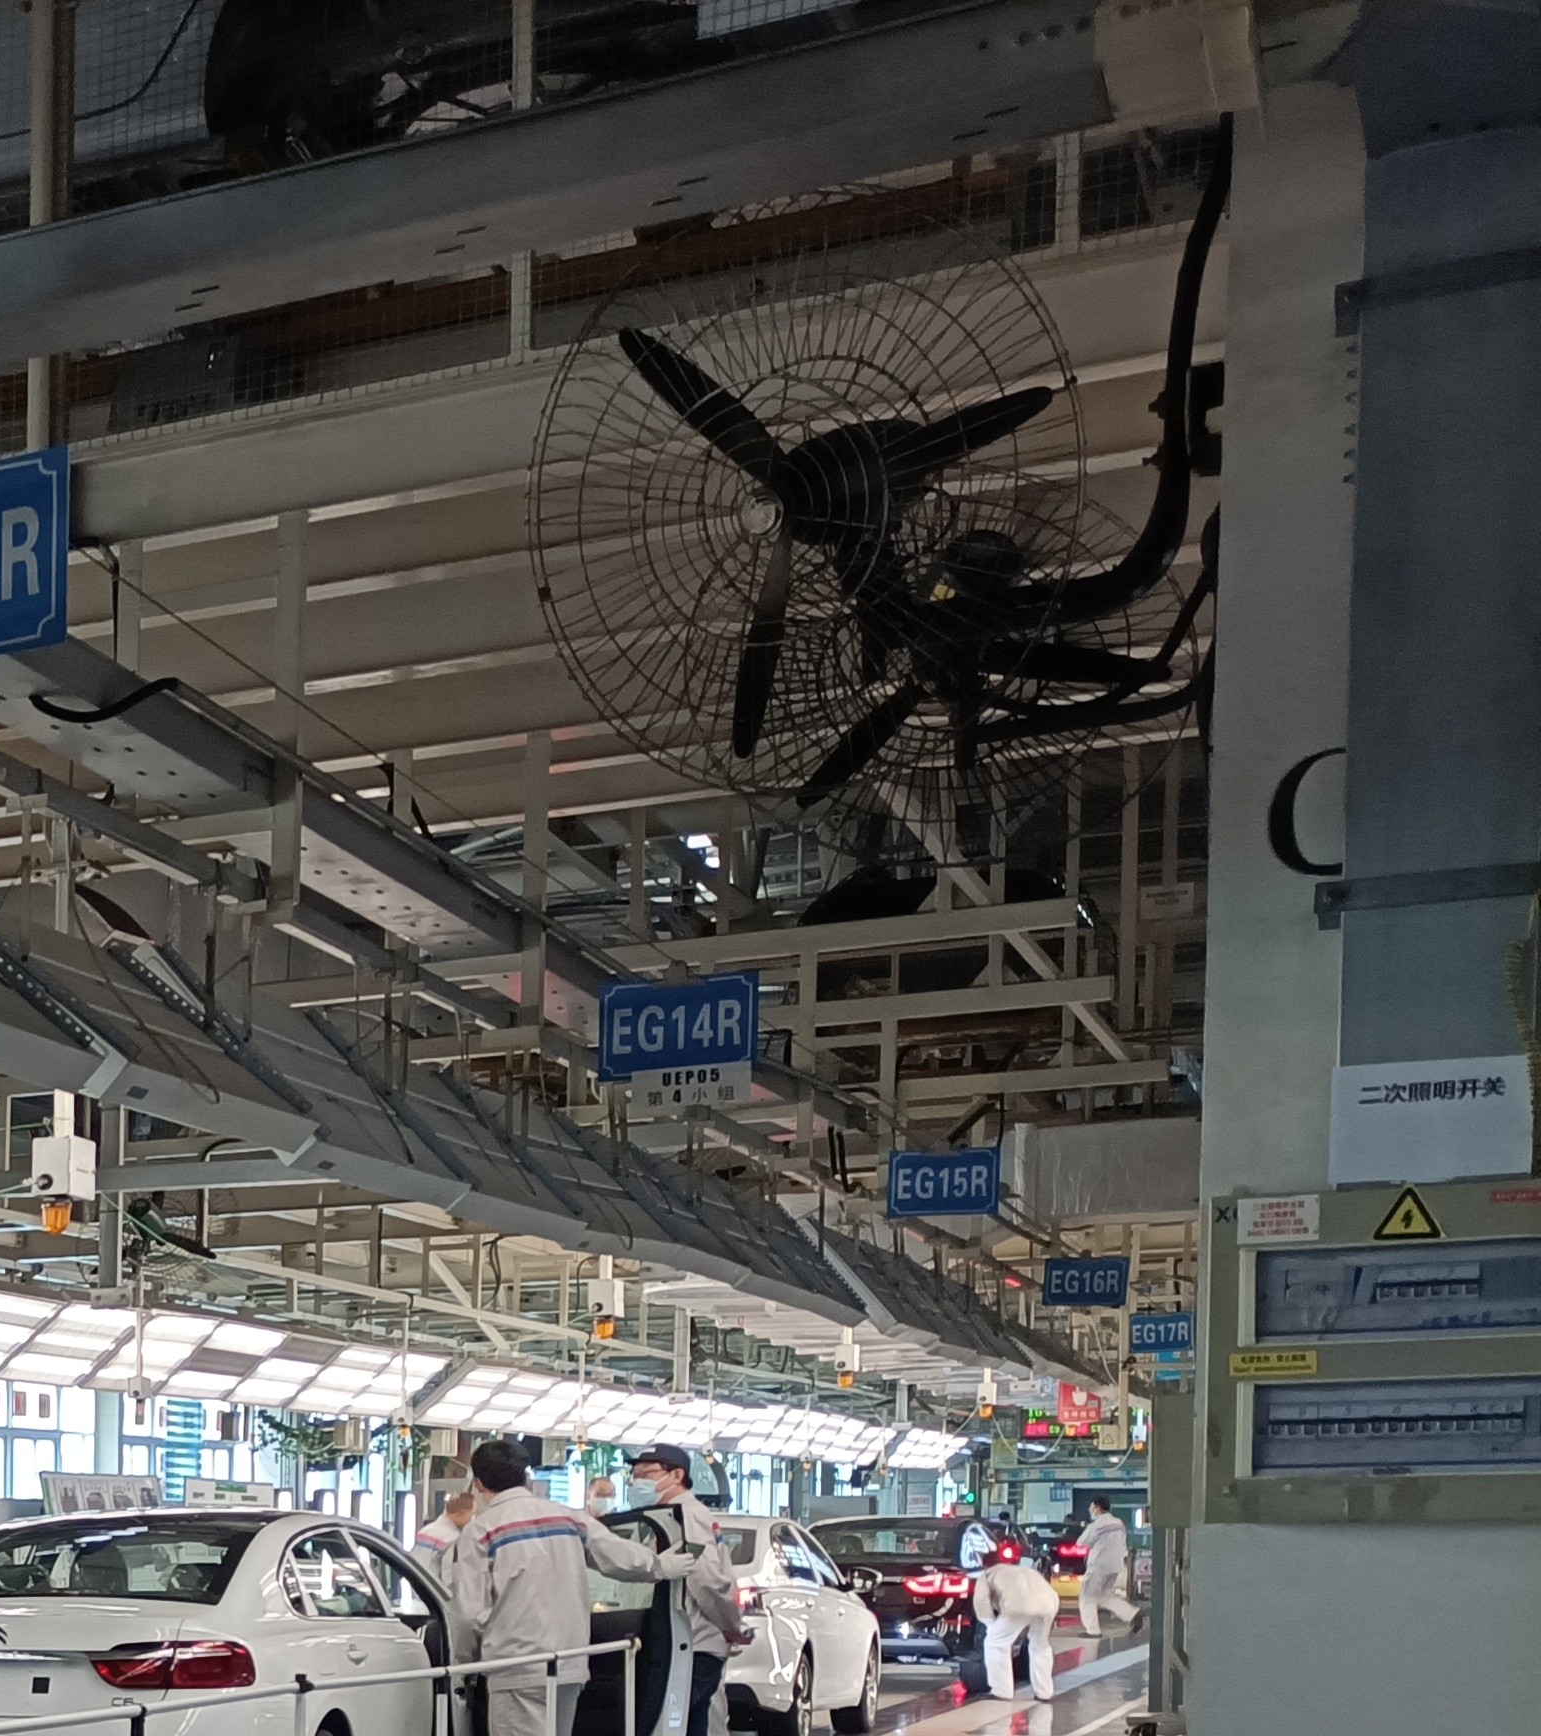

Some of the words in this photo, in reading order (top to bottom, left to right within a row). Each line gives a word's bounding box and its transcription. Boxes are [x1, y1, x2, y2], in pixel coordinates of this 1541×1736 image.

[612, 999, 742, 1056] EG14R
[662, 1067, 721, 1087] UEP05
[1358, 1076, 1507, 1105] 二次照明开关
[896, 1165, 989, 1200] EG15R
[1050, 1269, 1120, 1294] EG16R
[1132, 1321, 1189, 1345] EG17R
